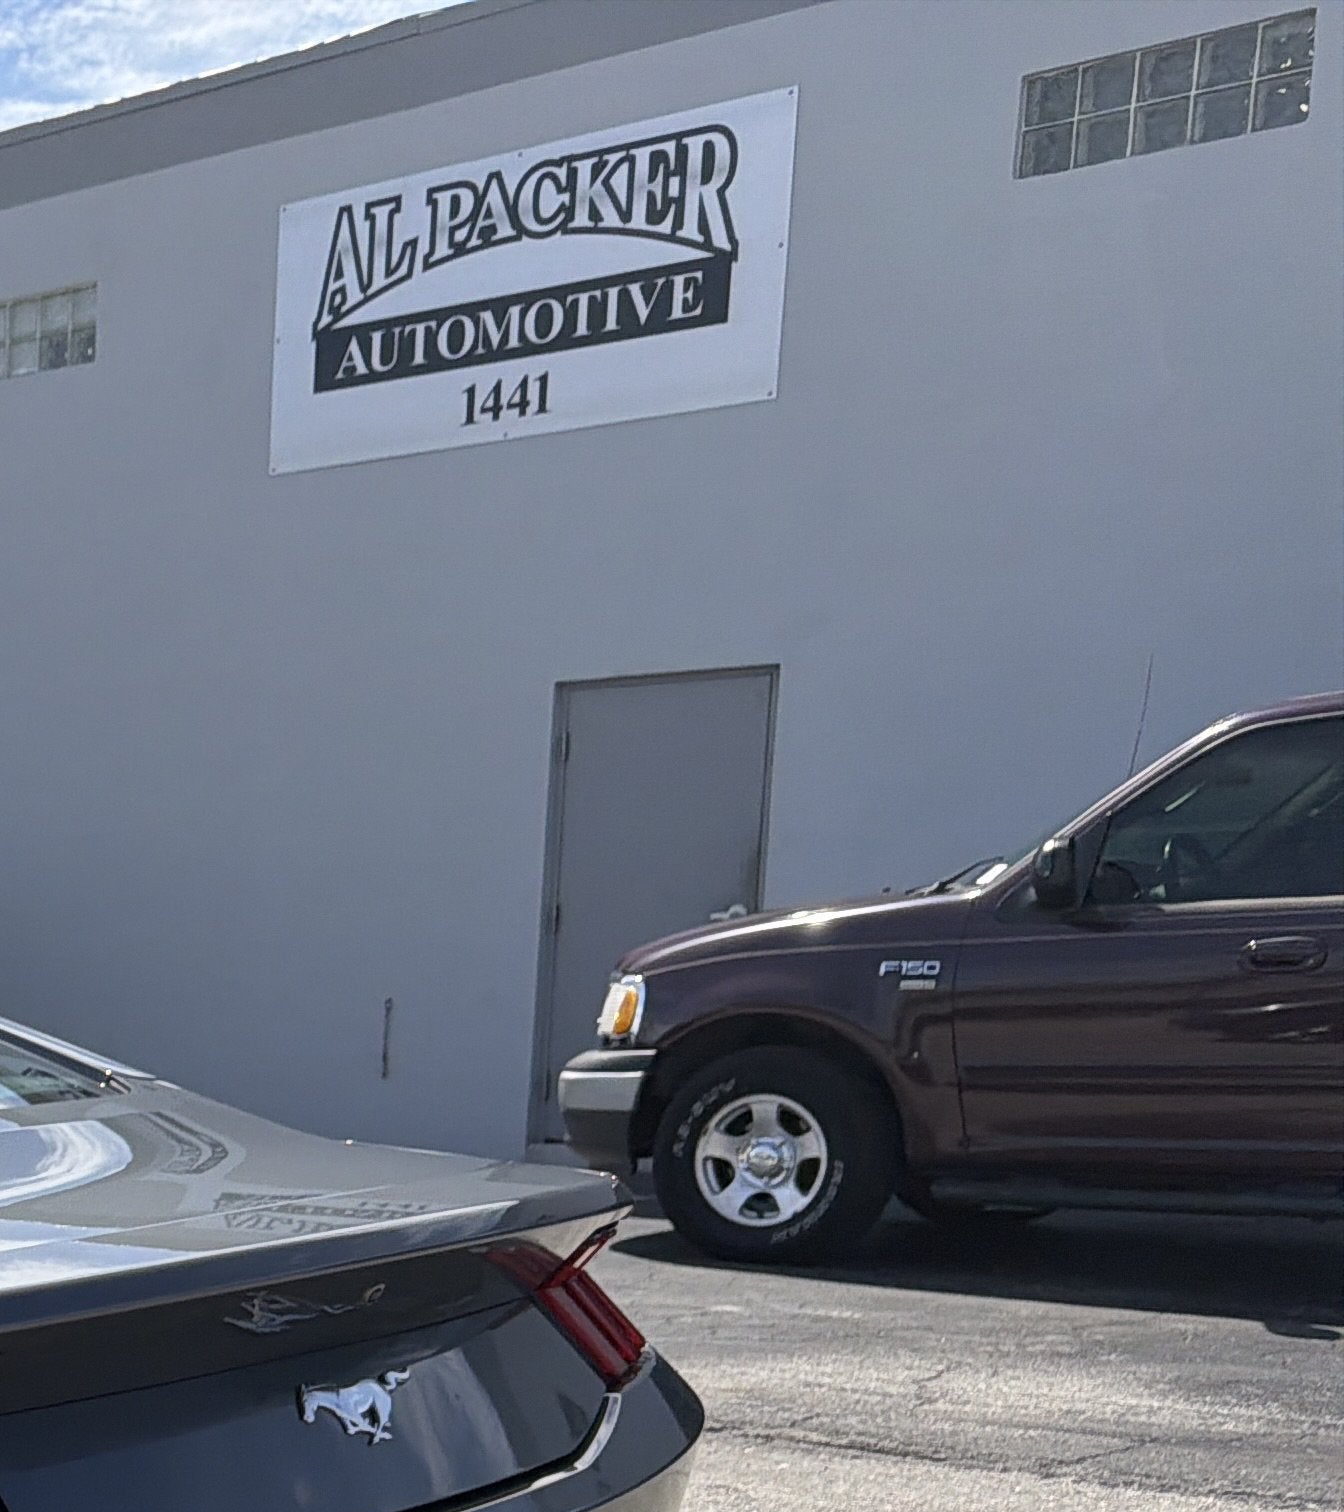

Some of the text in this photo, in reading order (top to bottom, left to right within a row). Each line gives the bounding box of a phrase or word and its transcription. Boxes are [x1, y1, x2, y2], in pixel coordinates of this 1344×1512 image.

[312, 123, 739, 336] AL PACKER
[334, 269, 704, 380] AUTOMOTIVE
[460, 370, 551, 427] 1441
